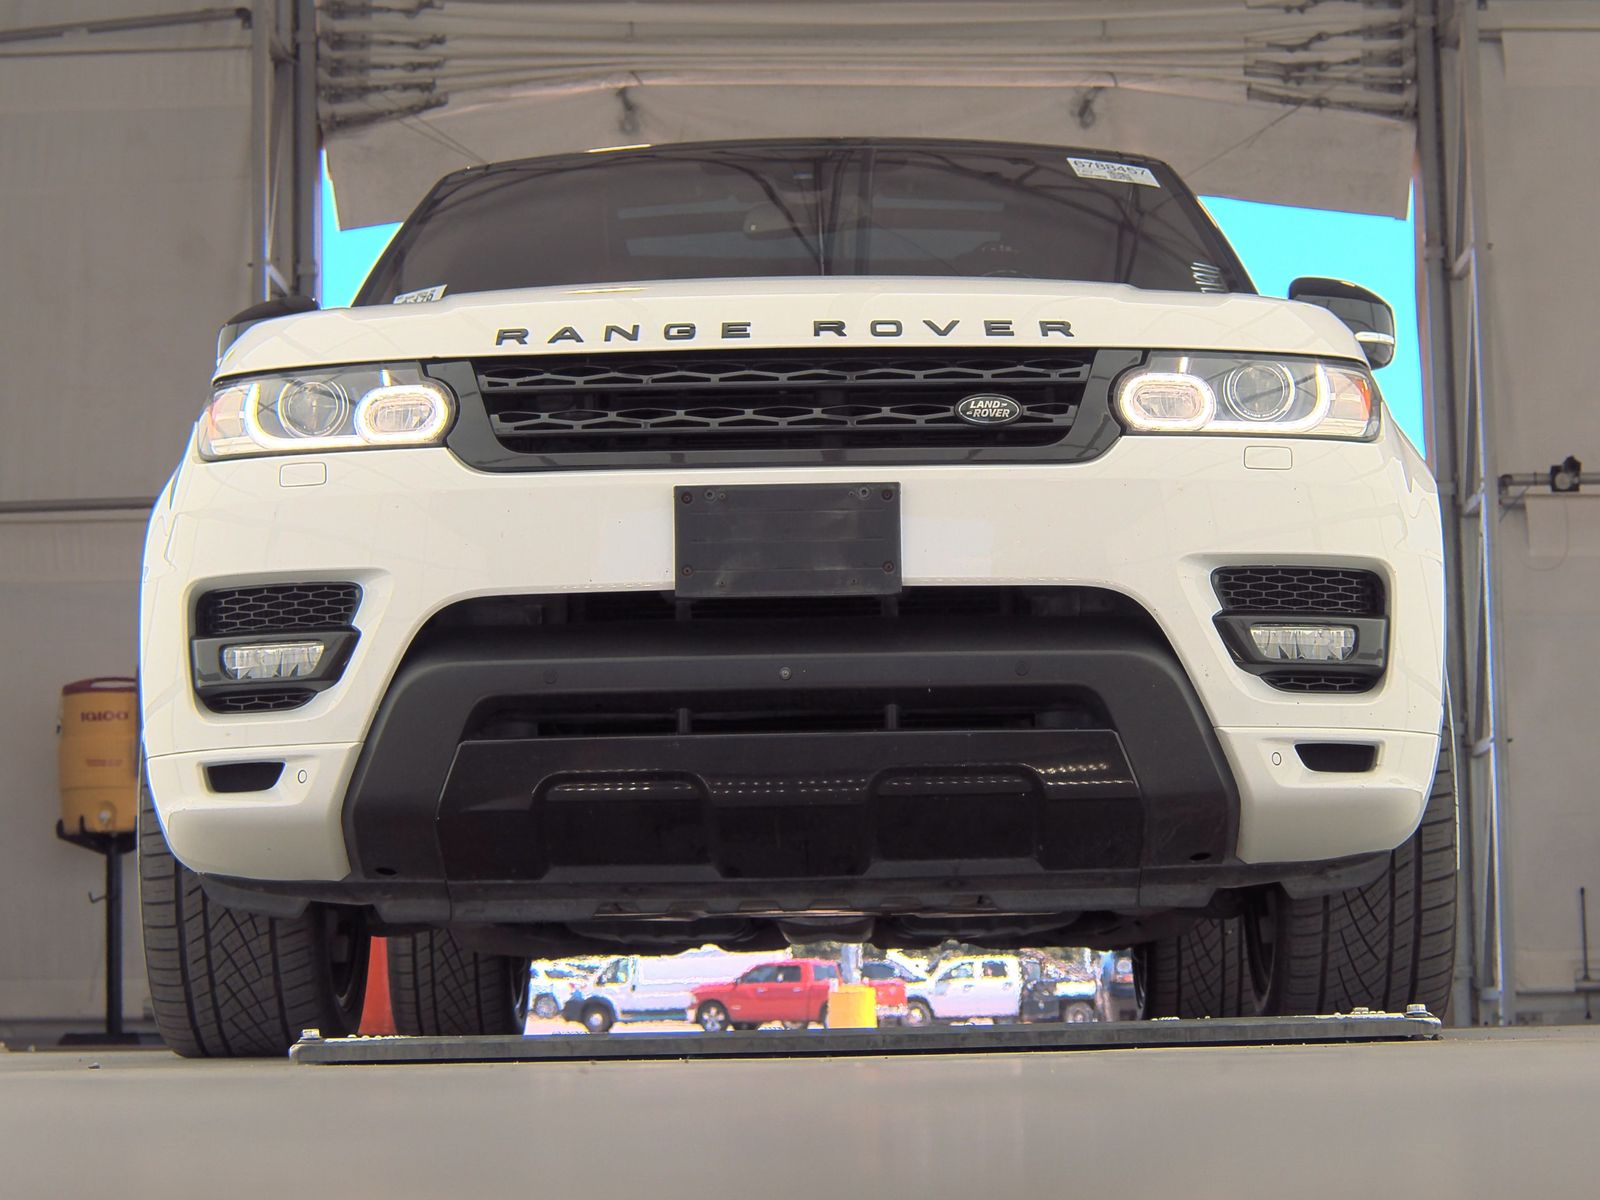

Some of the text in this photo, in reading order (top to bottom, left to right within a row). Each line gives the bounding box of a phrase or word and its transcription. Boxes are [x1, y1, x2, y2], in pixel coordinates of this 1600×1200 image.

[495, 320, 1075, 346] RANGE ROVER
[969, 400, 1001, 409] LAND
[972, 408, 1011, 418] ROVER
